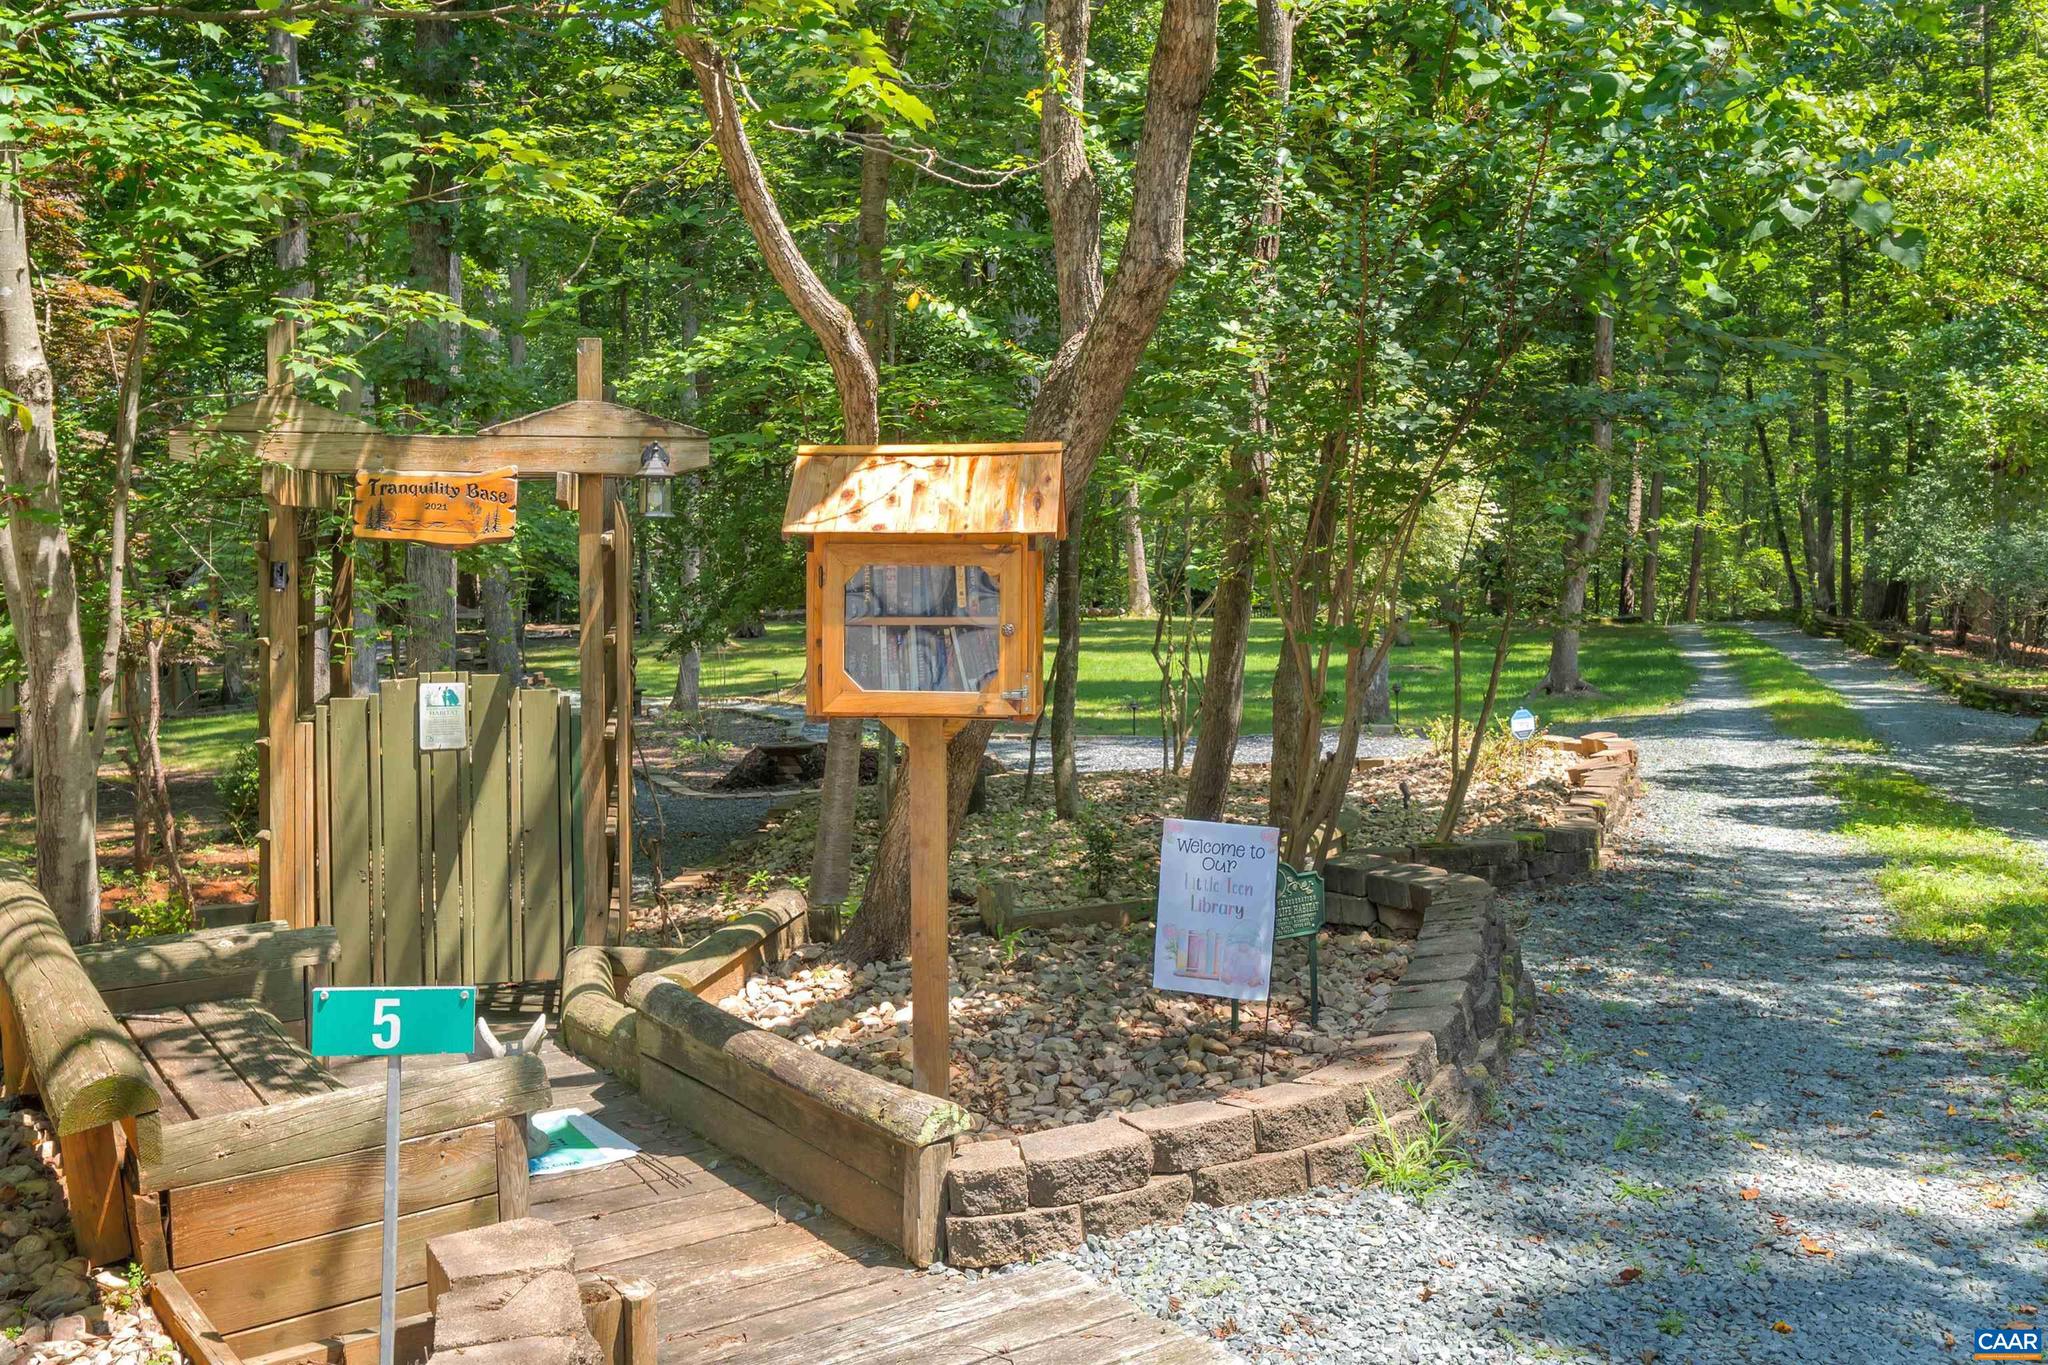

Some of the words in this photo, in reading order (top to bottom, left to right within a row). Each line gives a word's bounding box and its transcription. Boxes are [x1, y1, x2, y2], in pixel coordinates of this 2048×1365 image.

[368, 478, 460, 498] Tranquility
[466, 483, 508, 503] Base
[425, 503, 448, 511] 2021
[1177, 838, 1245, 858] Welcome
[1250, 844, 1266, 860] to
[1202, 857, 1238, 873] Our
[1191, 894, 1244, 920] Library
[372, 998, 401, 1050] 5
